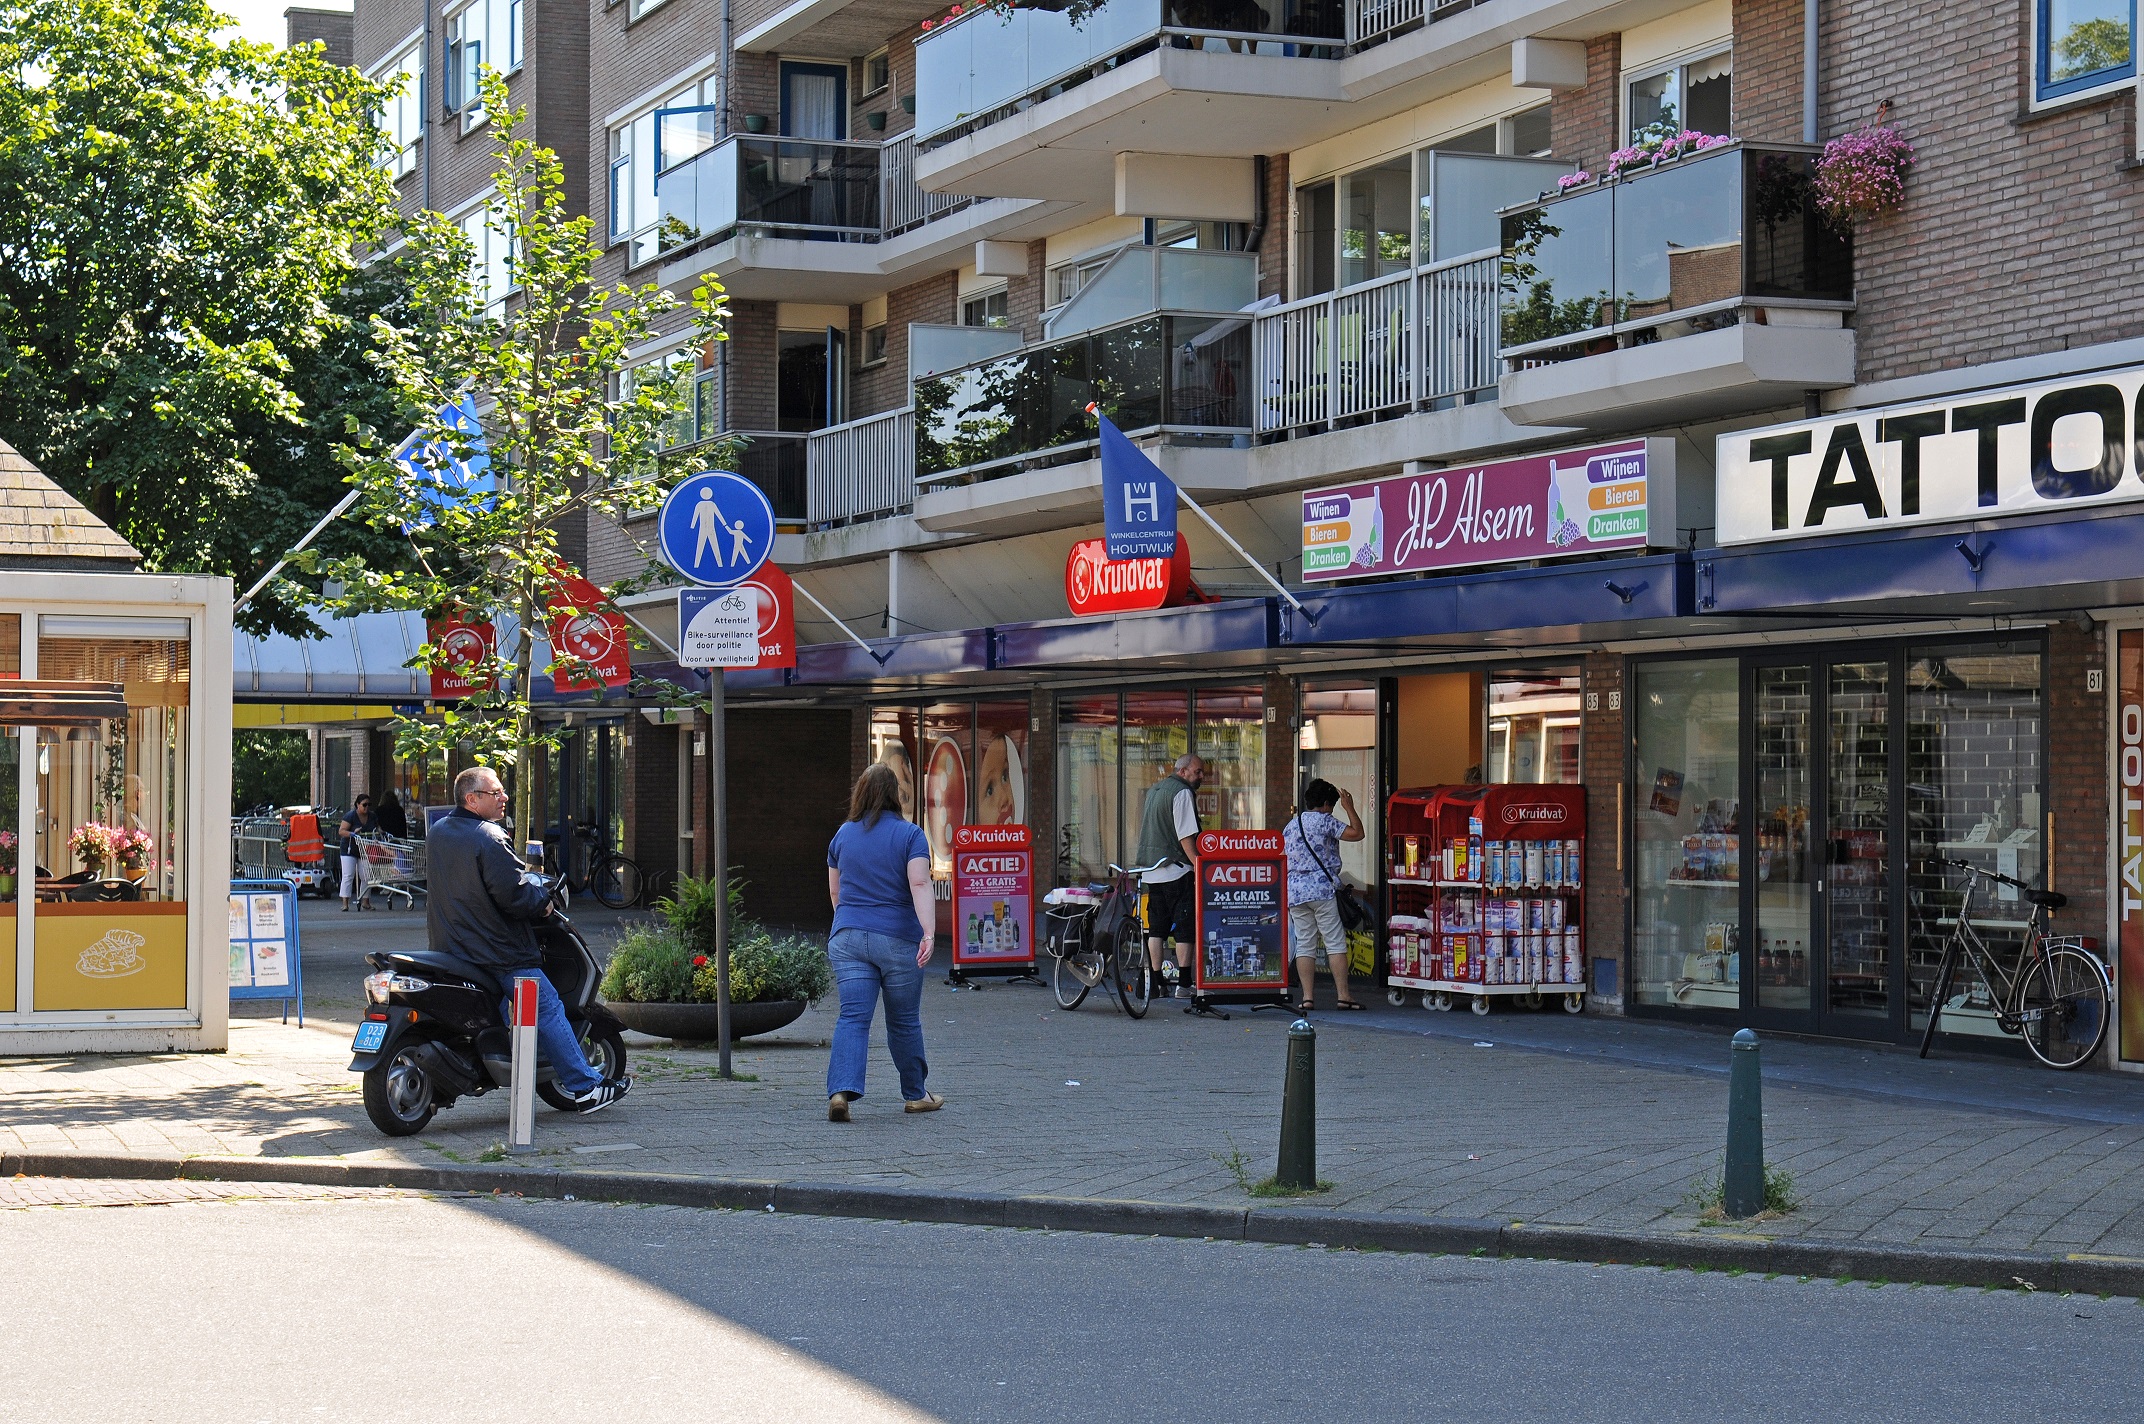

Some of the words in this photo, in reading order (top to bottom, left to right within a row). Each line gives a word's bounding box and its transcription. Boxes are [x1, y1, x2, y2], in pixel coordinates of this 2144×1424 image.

[1749, 383, 2144, 531] TATTO
[1600, 457, 1641, 480] Wijnen
[1604, 486, 1641, 506] Bieren
[1309, 502, 1340, 521] Wijnen
[1435, 469, 1535, 550] Alsem
[1592, 513, 1641, 535] Dranken
[1110, 530, 1174, 540] WINKELCENTRUM
[1309, 527, 1338, 542] Bieren
[1110, 542, 1174, 555] HOUTWIJK
[1309, 549, 1347, 566] Dranken
[1093, 557, 1164, 596] Kruidvat
[687, 631, 754, 639] Bike-surveillance
[717, 641, 742, 650] politie
[718, 655, 754, 664] veiligheid
[442, 676, 471, 688] Kruid
[2089, 672, 2101, 689] 81
[1588, 695, 1598, 709] 85
[1609, 694, 1620, 708] 83
[1518, 807, 1563, 819] Kruidvat
[2122, 704, 2142, 921] TATTOO
[973, 829, 1025, 843] Kruidvat
[1219, 835, 1278, 850] Kruidvat
[965, 857, 1020, 873] ACTIE!
[1210, 866, 1272, 883] ACTIE!
[969, 878, 985, 887] 2+1
[986, 877, 1017, 887] GRATIS
[1213, 891, 1231, 902] 2+1
[1233, 890, 1270, 902] GRATIS
[367, 1025, 384, 1036] D23
[363, 1036, 380, 1047] 8LP
